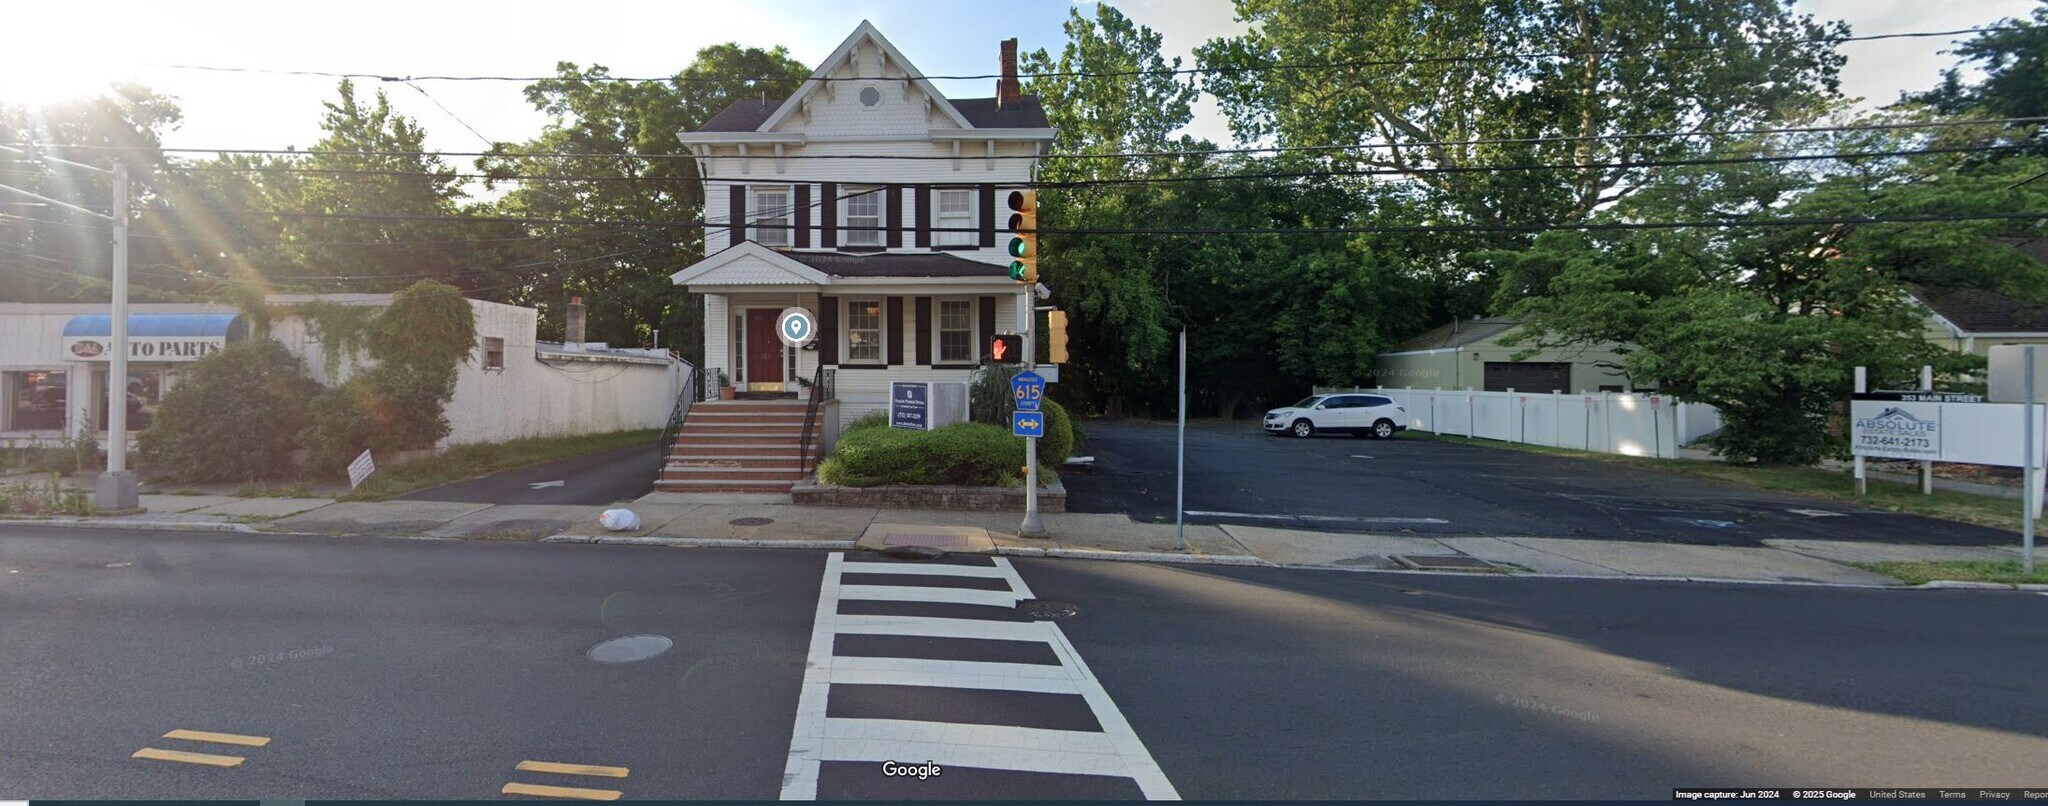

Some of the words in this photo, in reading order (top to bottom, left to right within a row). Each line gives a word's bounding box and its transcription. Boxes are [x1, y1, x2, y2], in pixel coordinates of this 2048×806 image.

[158, 341, 220, 356] PARTS
[1016, 385, 1040, 399] 615
[1856, 420, 1936, 431] ABSOLUTE
[1861, 436, 1929, 447] 732-641-2173
